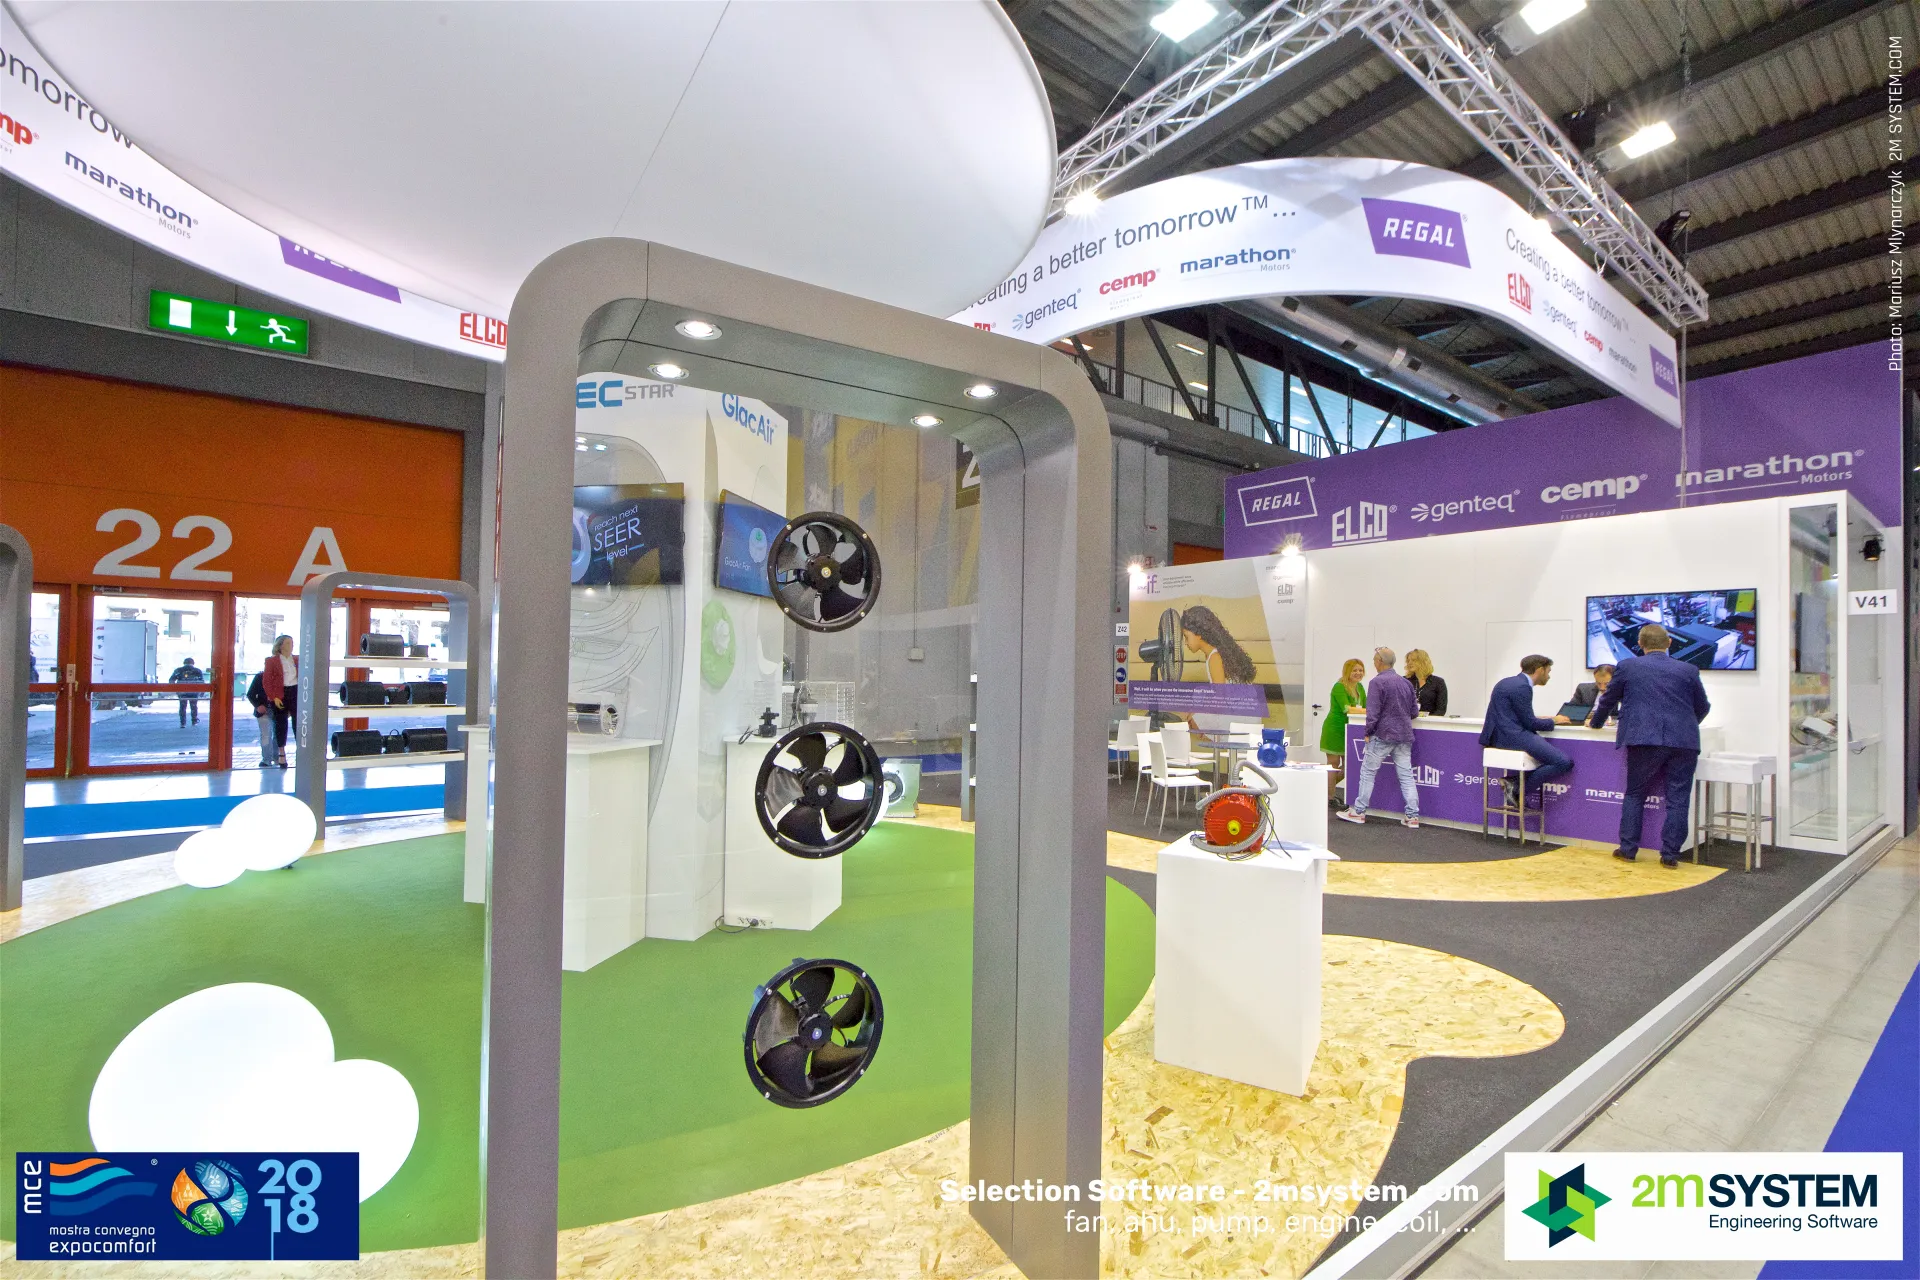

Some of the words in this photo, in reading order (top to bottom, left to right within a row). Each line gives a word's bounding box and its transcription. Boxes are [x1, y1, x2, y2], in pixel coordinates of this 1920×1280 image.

[158, 217, 191, 239] Motors
[1034, 265, 1043, 282] a
[1050, 237, 1107, 275] better
[1260, 263, 1290, 272] Motors
[1506, 228, 1551, 281] Creating
[1553, 267, 1558, 282] a
[1561, 269, 1585, 302] better
[1801, 471, 1853, 484] Motors
[594, 515, 617, 531] reach
[620, 505, 638, 519] next
[594, 517, 641, 551] SEER
[92, 508, 233, 583] 22
[287, 527, 348, 586] A
[607, 545, 628, 560] level
[1856, 595, 1888, 609] V41
